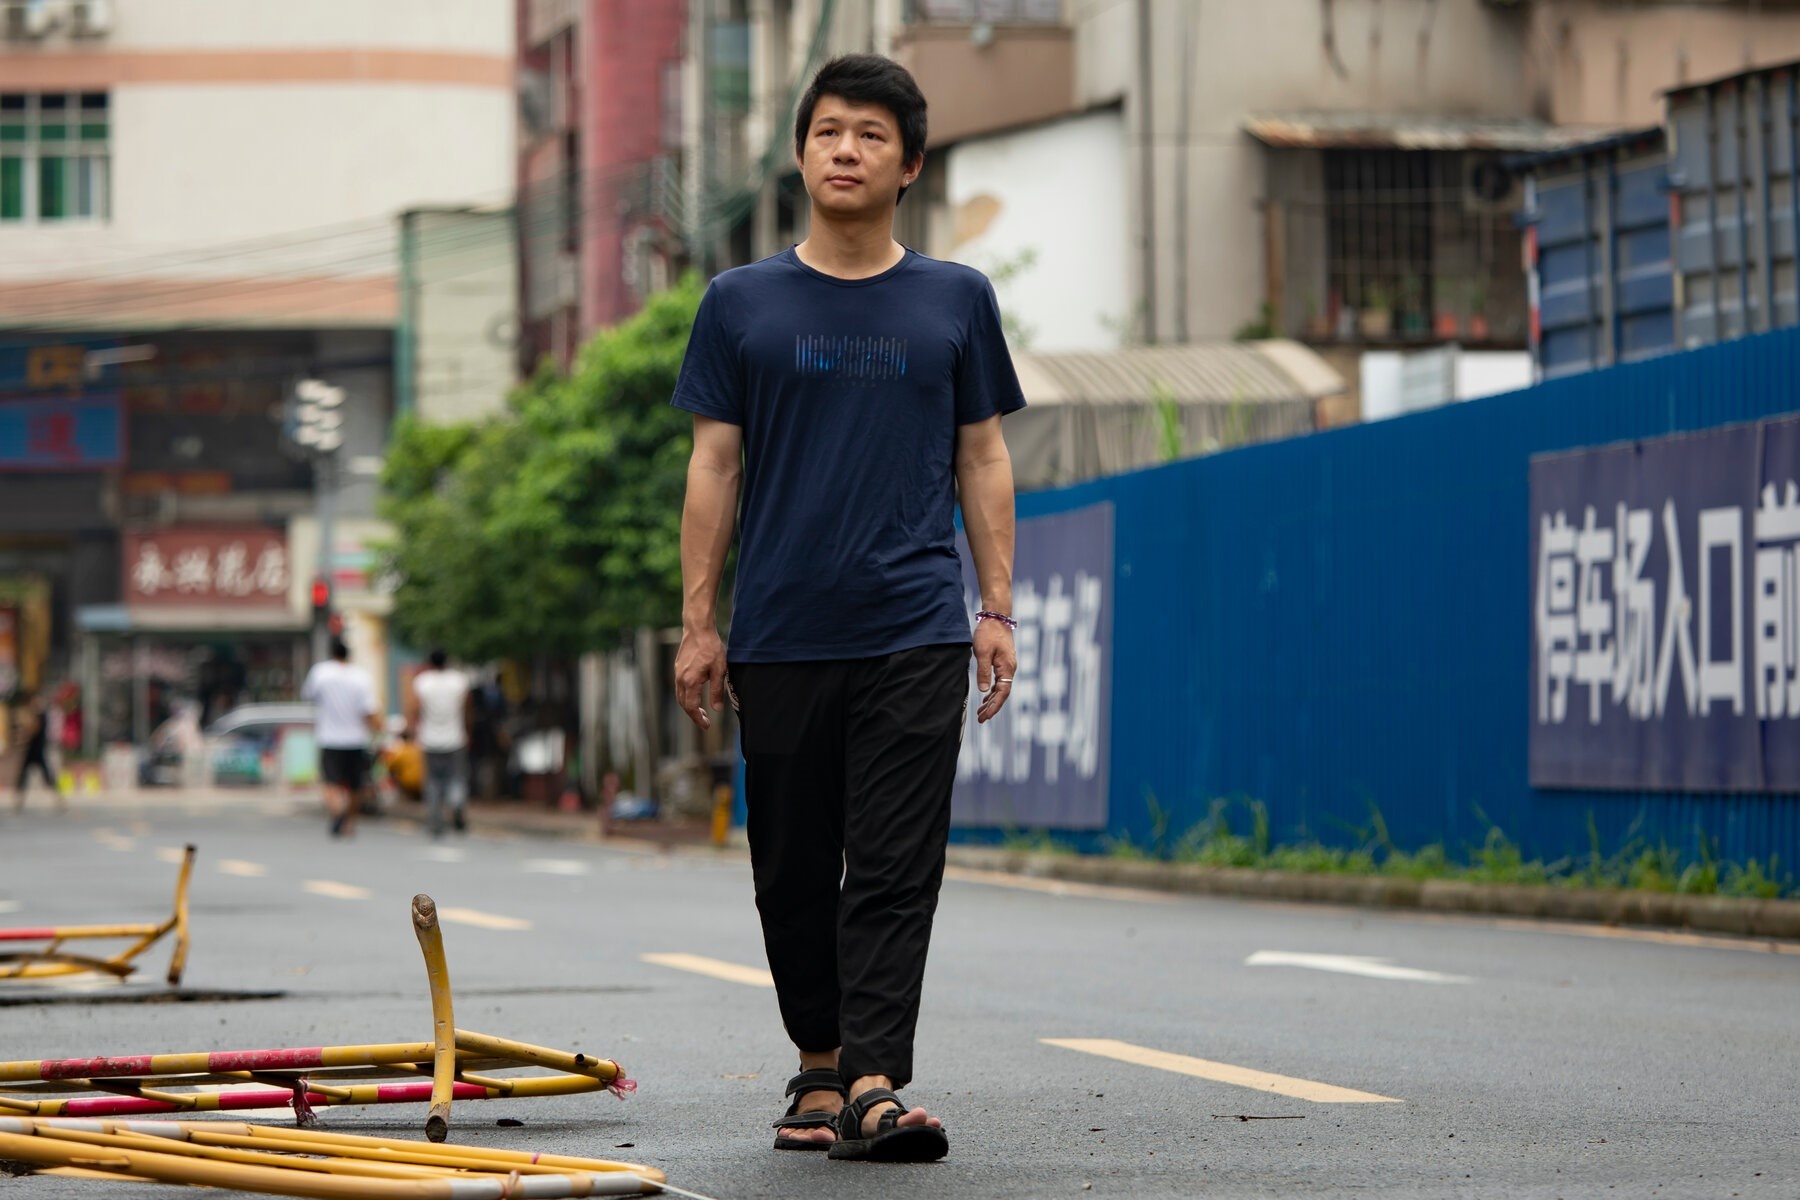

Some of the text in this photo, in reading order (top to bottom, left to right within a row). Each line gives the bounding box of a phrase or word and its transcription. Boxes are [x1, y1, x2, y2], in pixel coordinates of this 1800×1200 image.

[1536, 478, 1800, 725] 停车场入口前
